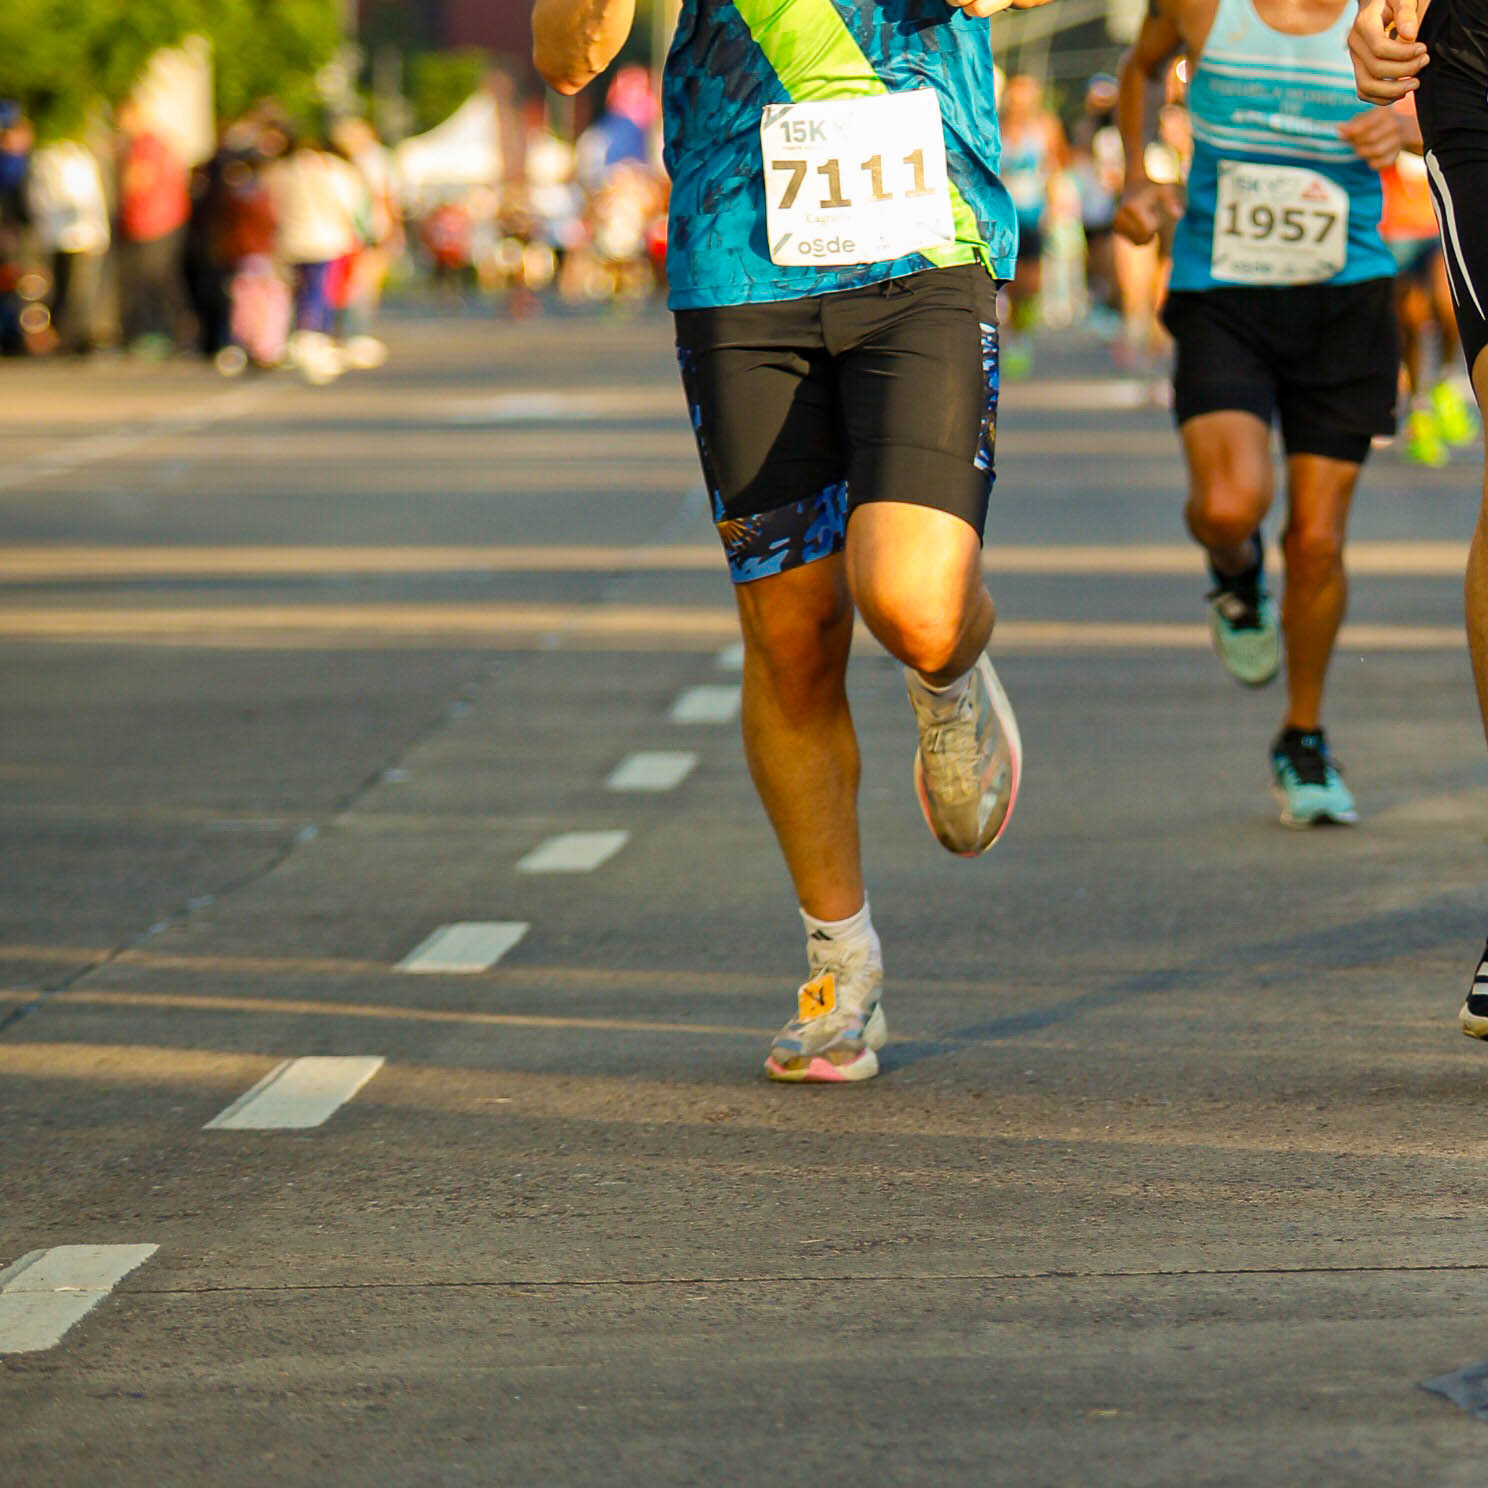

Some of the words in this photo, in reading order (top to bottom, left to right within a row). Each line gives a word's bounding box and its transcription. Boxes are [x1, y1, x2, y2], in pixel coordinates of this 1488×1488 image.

[780, 119, 827, 143] 15K
[771, 148, 937, 209] 7111
[1224, 201, 1338, 244] 1957
